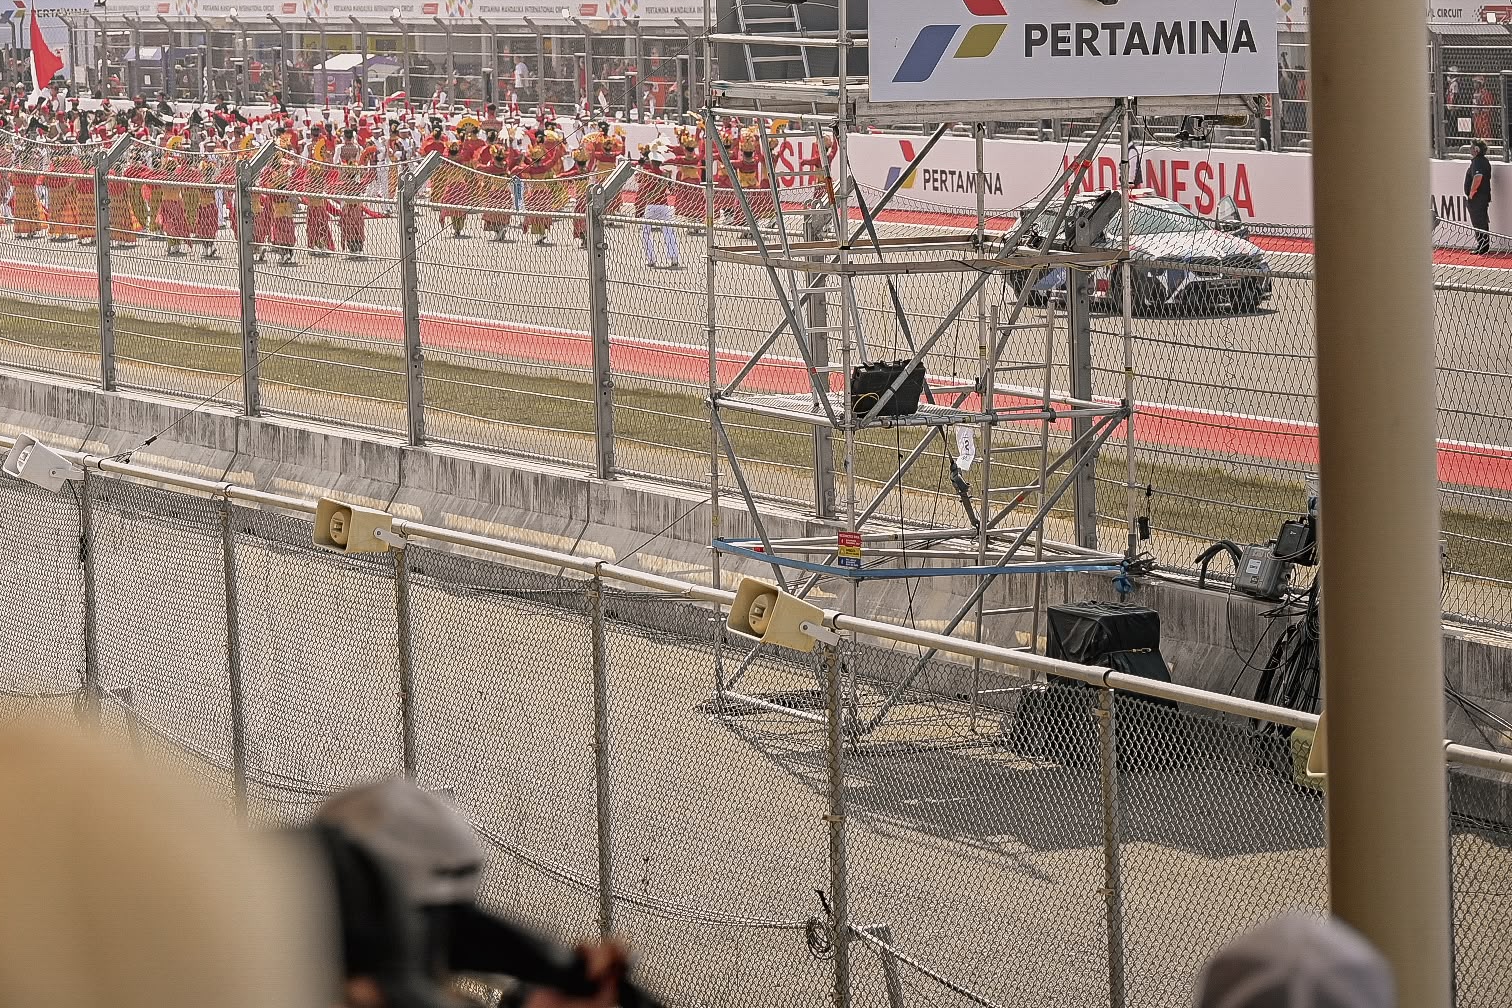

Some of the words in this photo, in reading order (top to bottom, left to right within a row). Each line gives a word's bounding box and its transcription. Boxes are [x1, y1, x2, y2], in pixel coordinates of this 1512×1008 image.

[1436, 8, 1462, 18] CIRCUIT
[1024, 19, 1258, 58] PERTAMINA
[922, 168, 1003, 195] PERTAMNA
